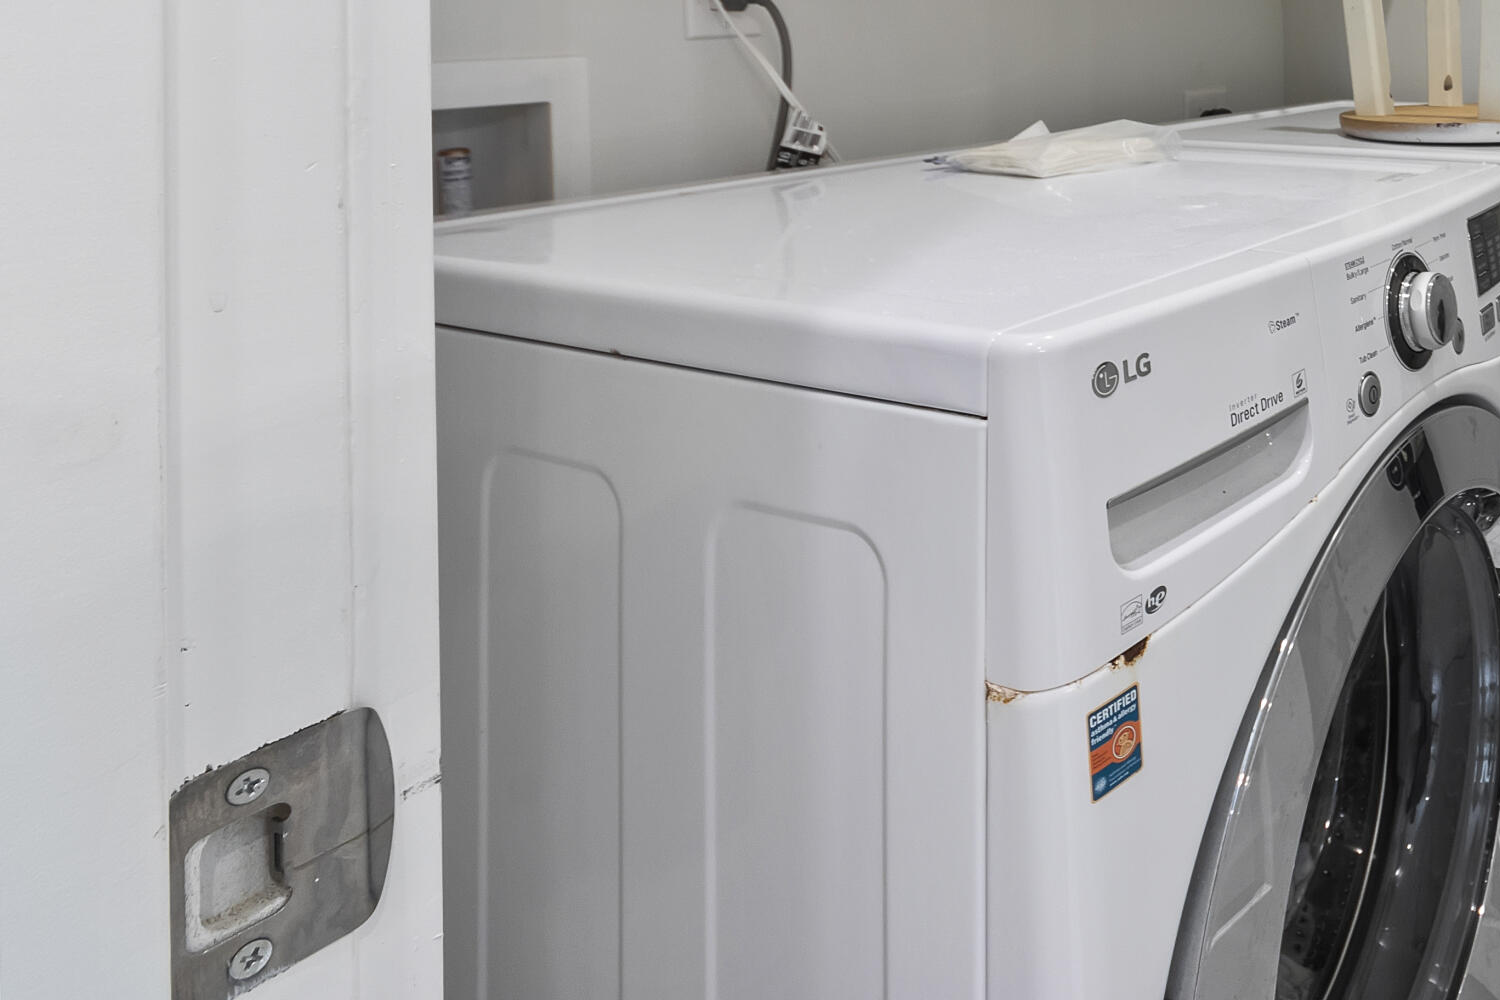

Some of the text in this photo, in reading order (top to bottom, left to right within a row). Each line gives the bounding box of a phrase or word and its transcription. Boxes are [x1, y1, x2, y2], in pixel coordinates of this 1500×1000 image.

[1122, 352, 1152, 384] LG
[1230, 390, 1284, 427] Direct Drive
[1089, 688, 1137, 728] CERTIFIED
[1090, 719, 1113, 738] asthma
[1117, 703, 1137, 720] allergy
